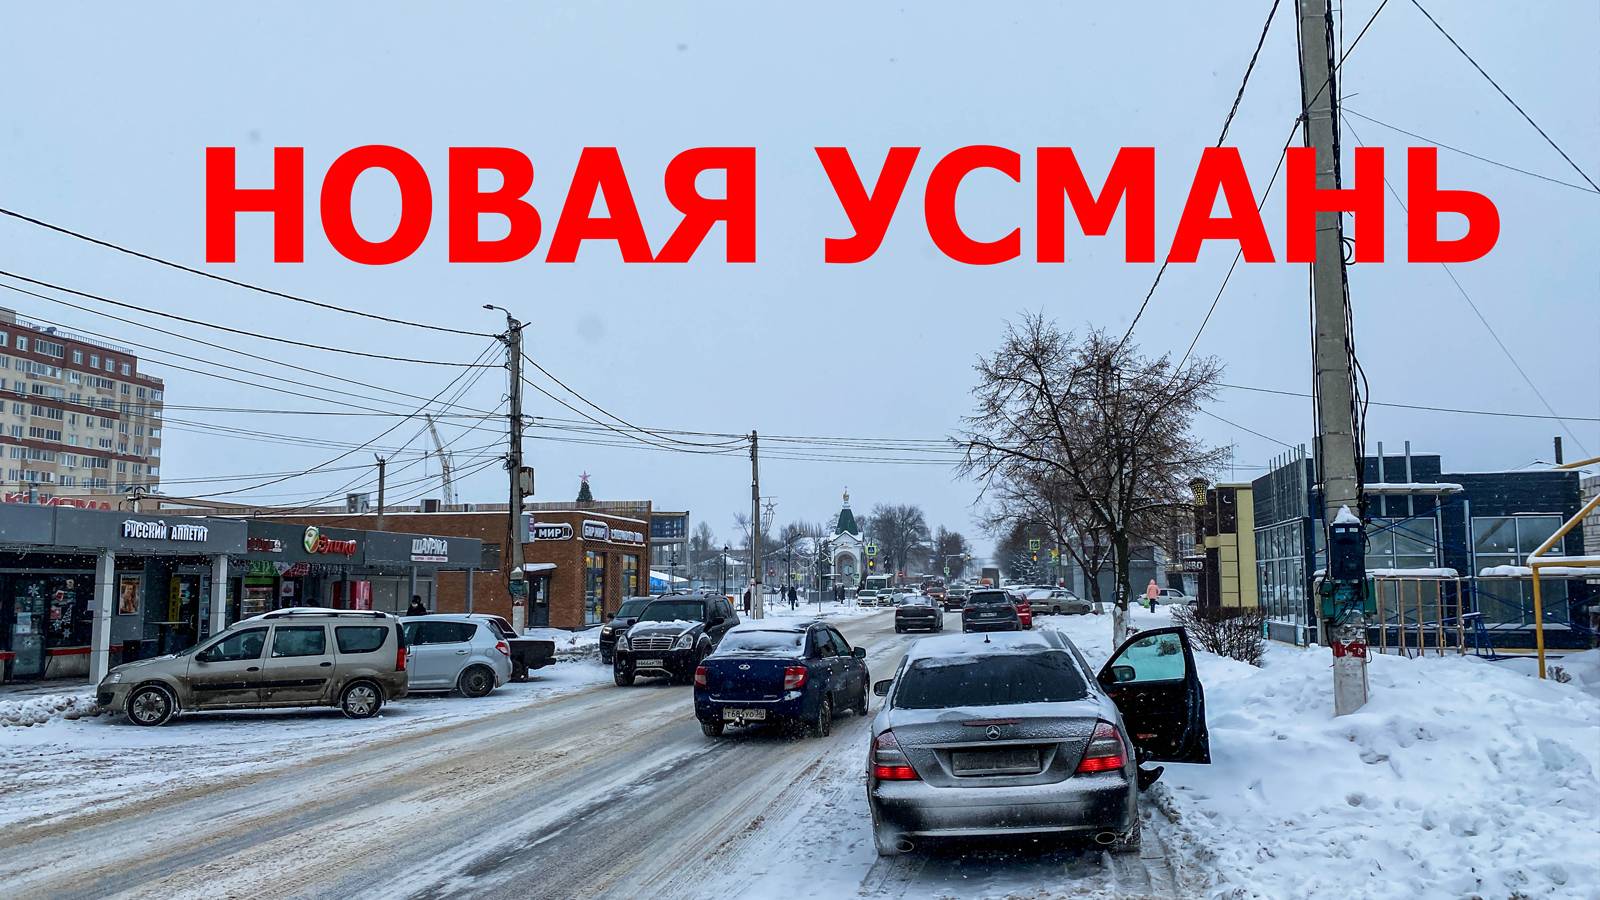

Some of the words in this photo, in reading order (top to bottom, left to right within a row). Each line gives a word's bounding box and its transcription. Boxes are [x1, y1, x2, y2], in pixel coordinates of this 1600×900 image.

[123, 521, 167, 539] РУССКИЙ
[171, 525, 208, 541] АППЕТИТ
[539, 528, 561, 538] МИР
[412, 538, 447, 555] ШАУРМА
